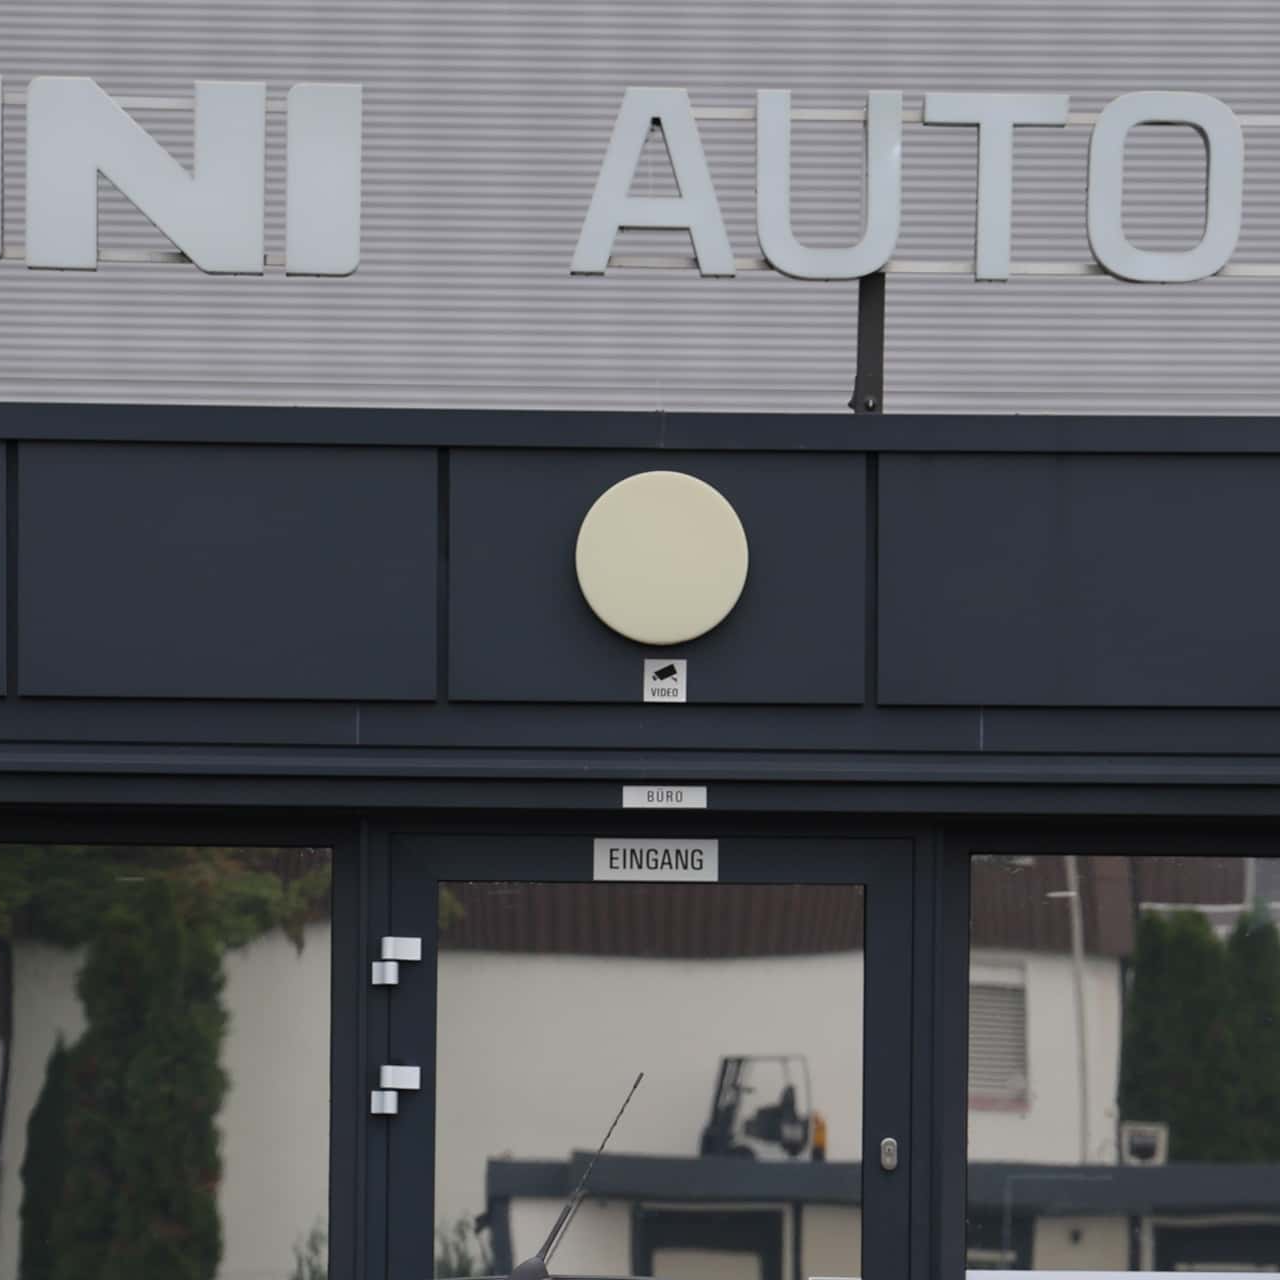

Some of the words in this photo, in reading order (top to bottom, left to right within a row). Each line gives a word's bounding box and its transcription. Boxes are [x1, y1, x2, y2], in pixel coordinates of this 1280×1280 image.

[569, 86, 1245, 284] AUTO
[650, 687, 679, 698] VIDEO
[646, 787, 684, 803] BÜRO
[609, 848, 704, 871] EINGANG
